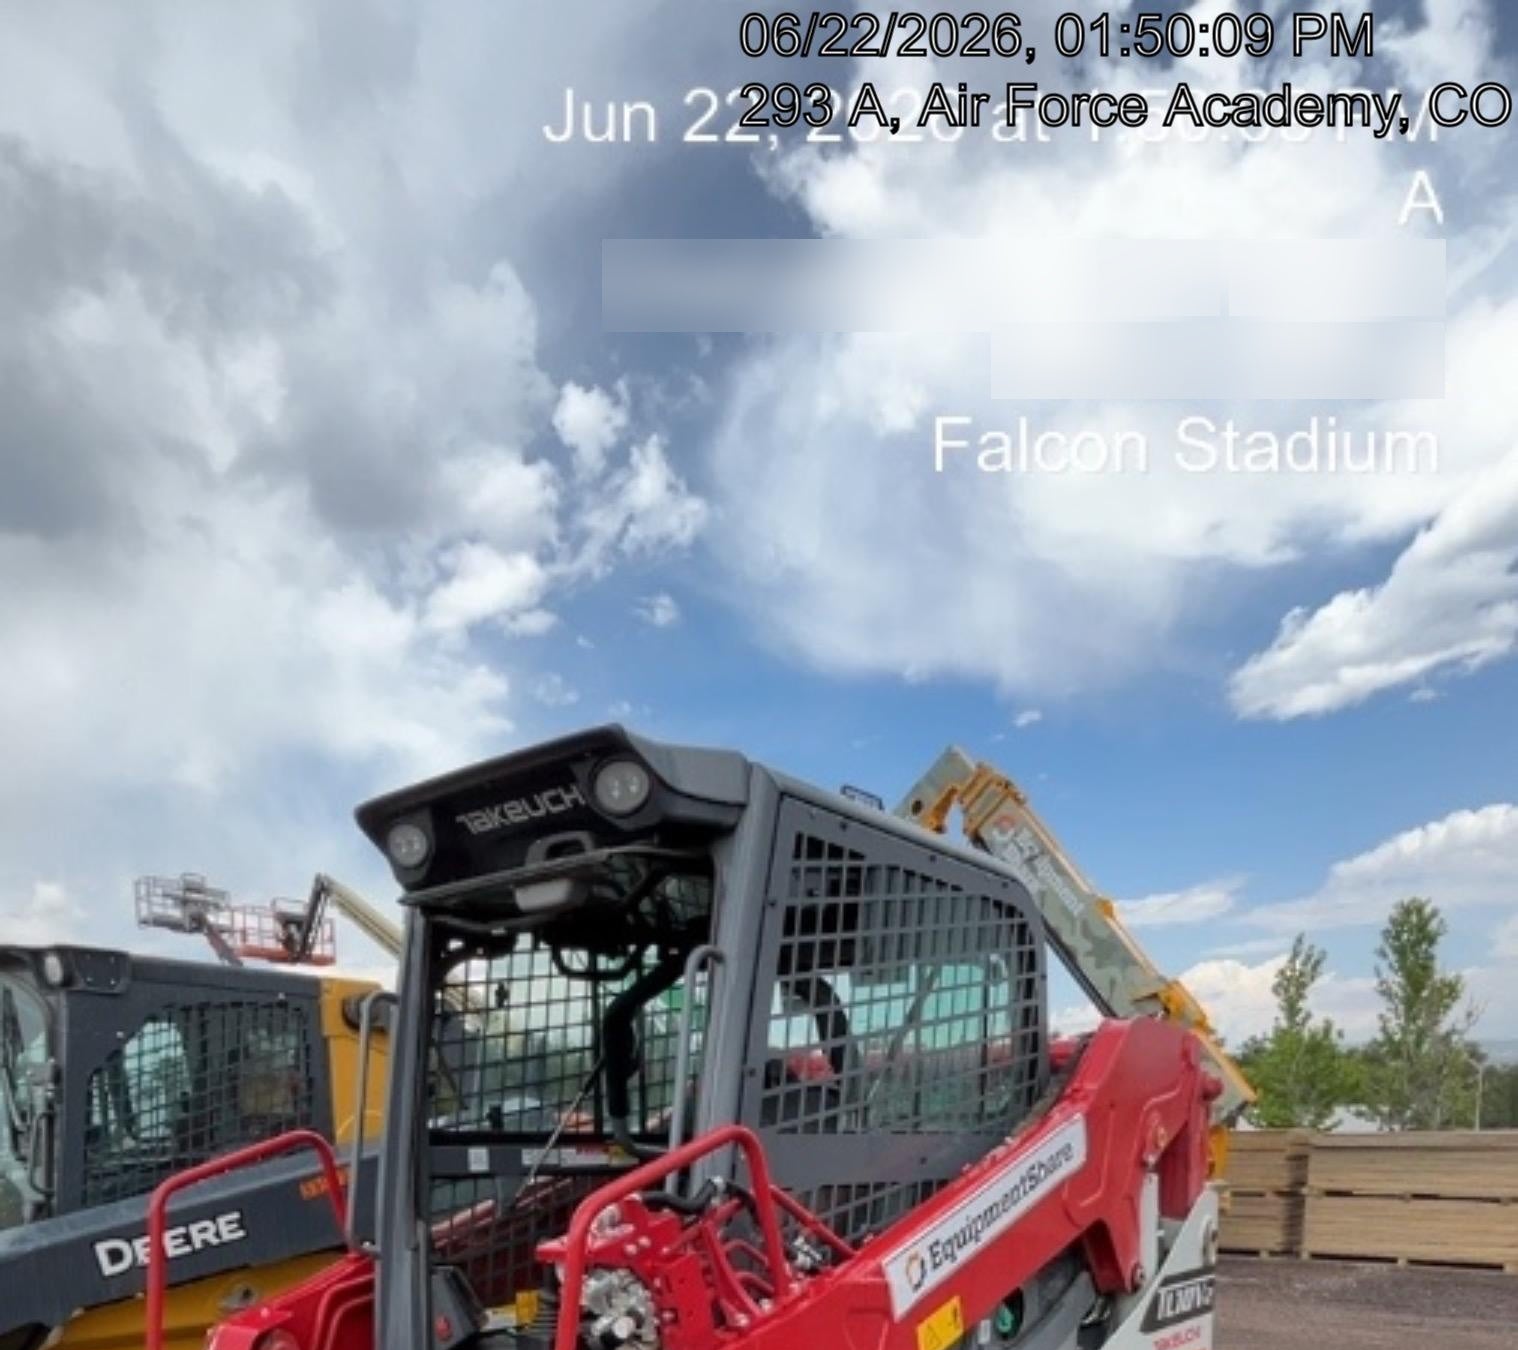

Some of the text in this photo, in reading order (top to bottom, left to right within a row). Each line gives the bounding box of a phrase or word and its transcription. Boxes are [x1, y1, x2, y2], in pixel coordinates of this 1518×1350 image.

[455, 784, 586, 835] TAKEUCH
[928, 1142, 1075, 1272] EquipmentShare
[94, 1211, 247, 1277] DEERE
